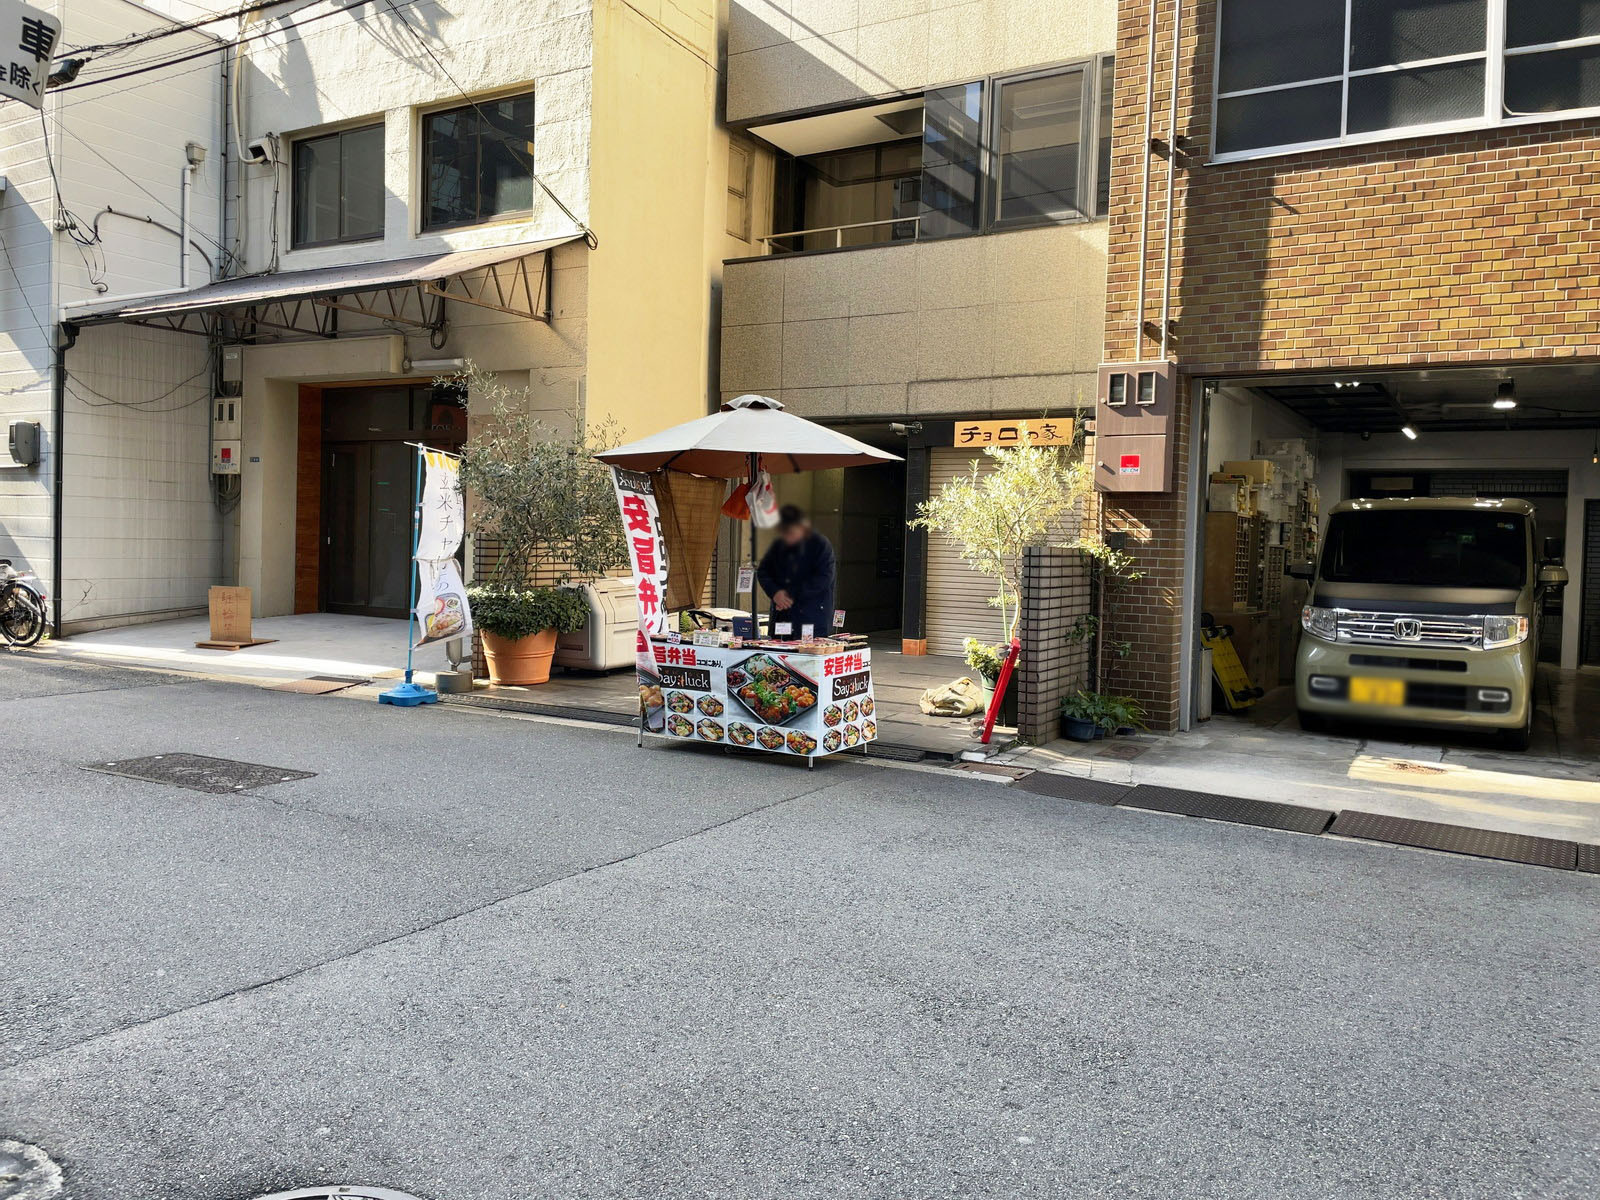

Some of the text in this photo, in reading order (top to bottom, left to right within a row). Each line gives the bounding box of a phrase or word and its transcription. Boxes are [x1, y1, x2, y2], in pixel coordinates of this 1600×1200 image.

[19, 15, 56, 63] 車
[824, 652, 862, 677] 安旨弁当
[684, 672, 710, 689] luck
[833, 674, 869, 697] Say luck
